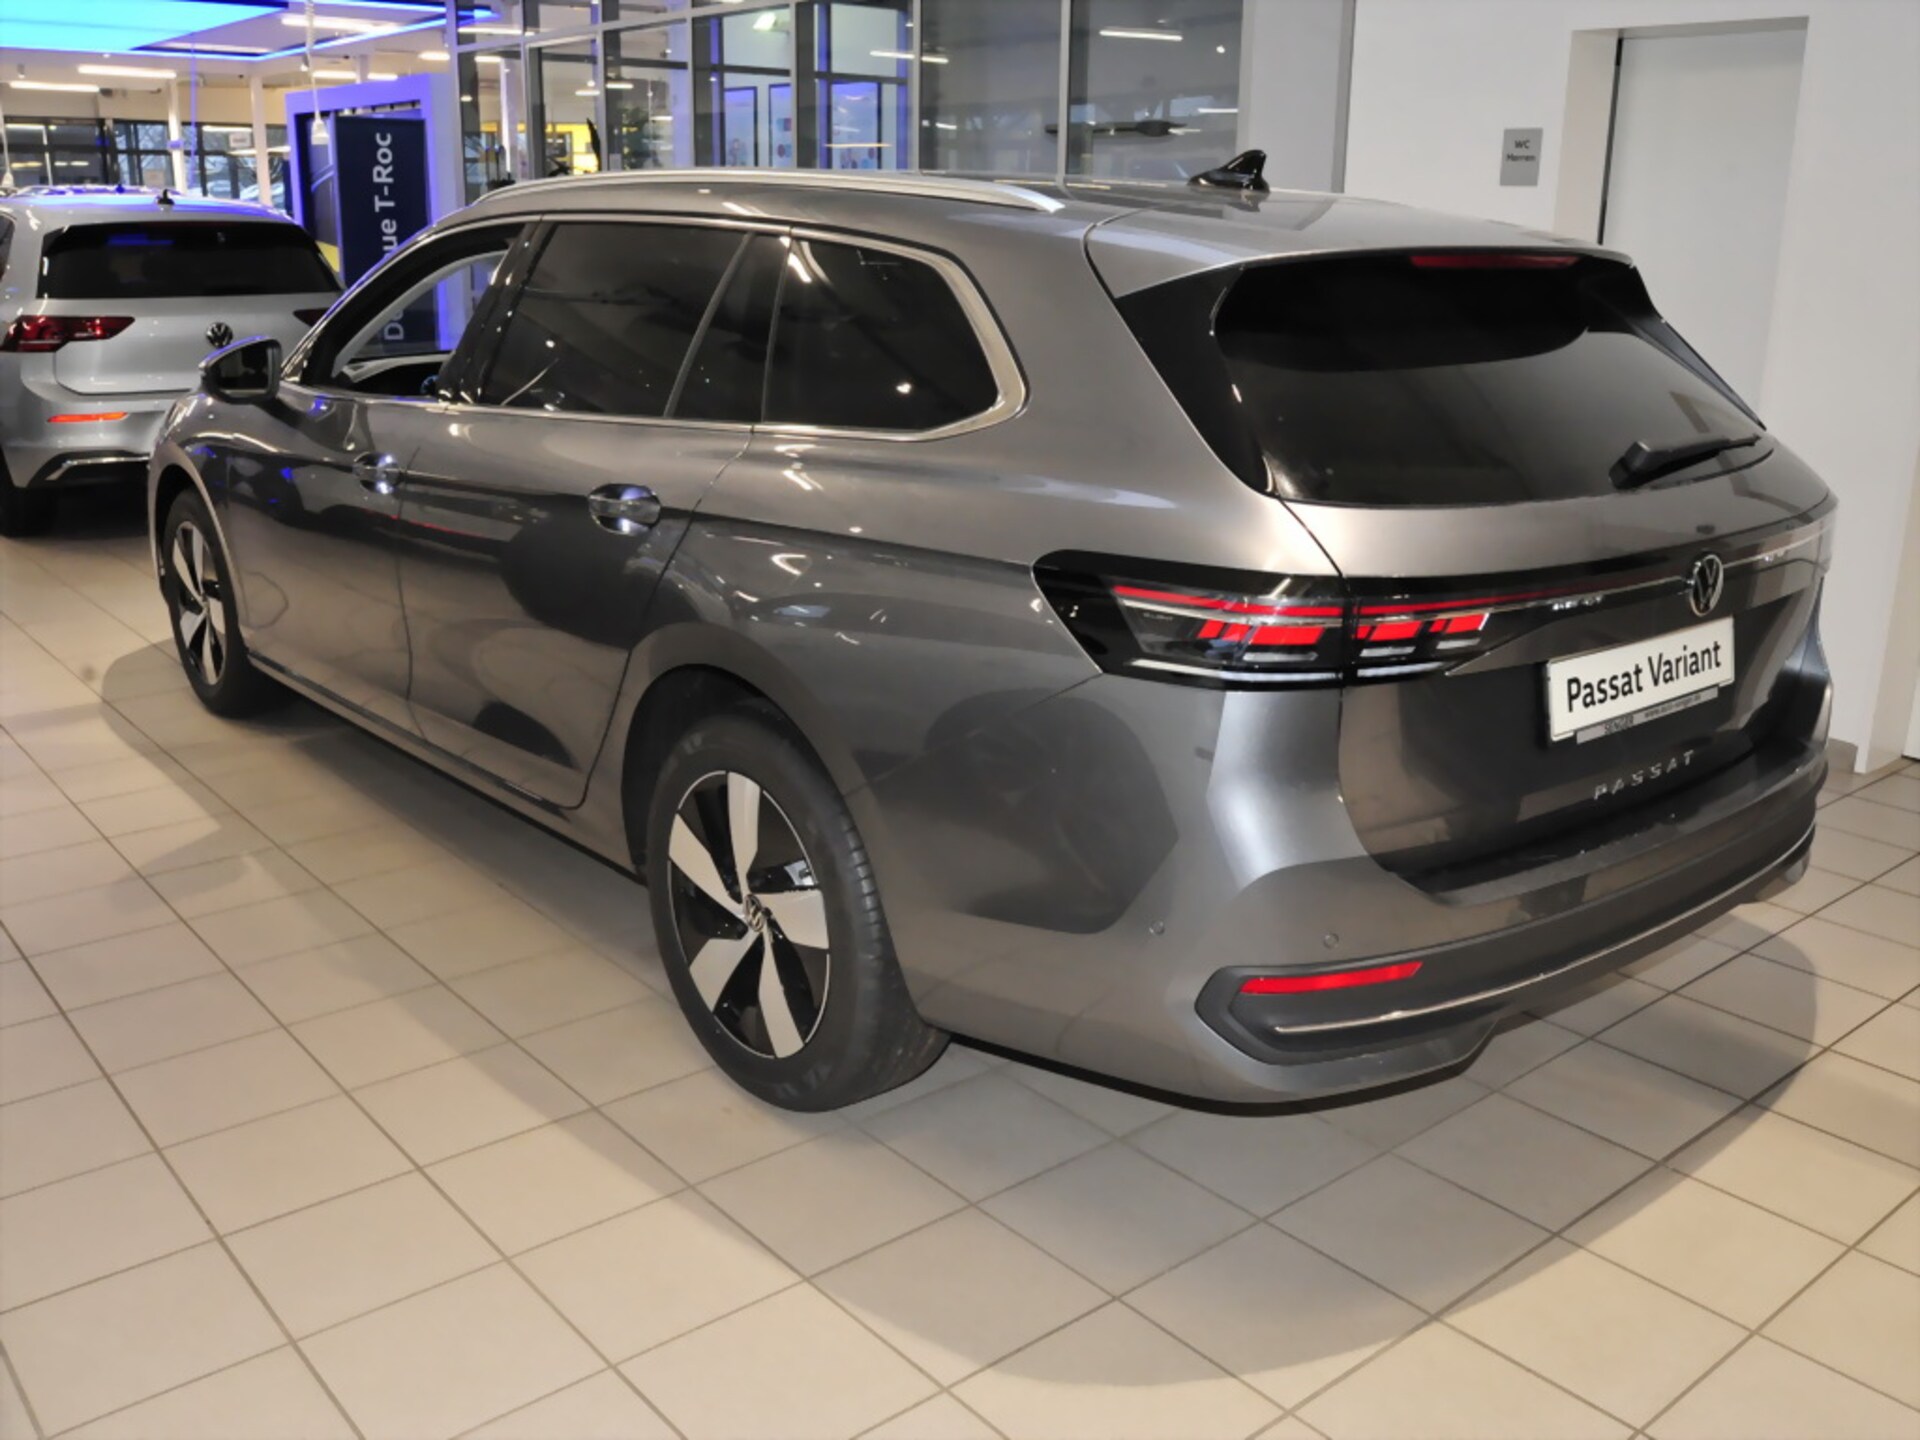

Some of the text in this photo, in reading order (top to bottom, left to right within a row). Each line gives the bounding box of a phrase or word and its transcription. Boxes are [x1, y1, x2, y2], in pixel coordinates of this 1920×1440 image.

[372, 132, 396, 213] T-Roc
[1514, 139, 1531, 149] WC
[1567, 641, 1722, 713] Passat Variant
[1593, 749, 1694, 800] PASSAT
